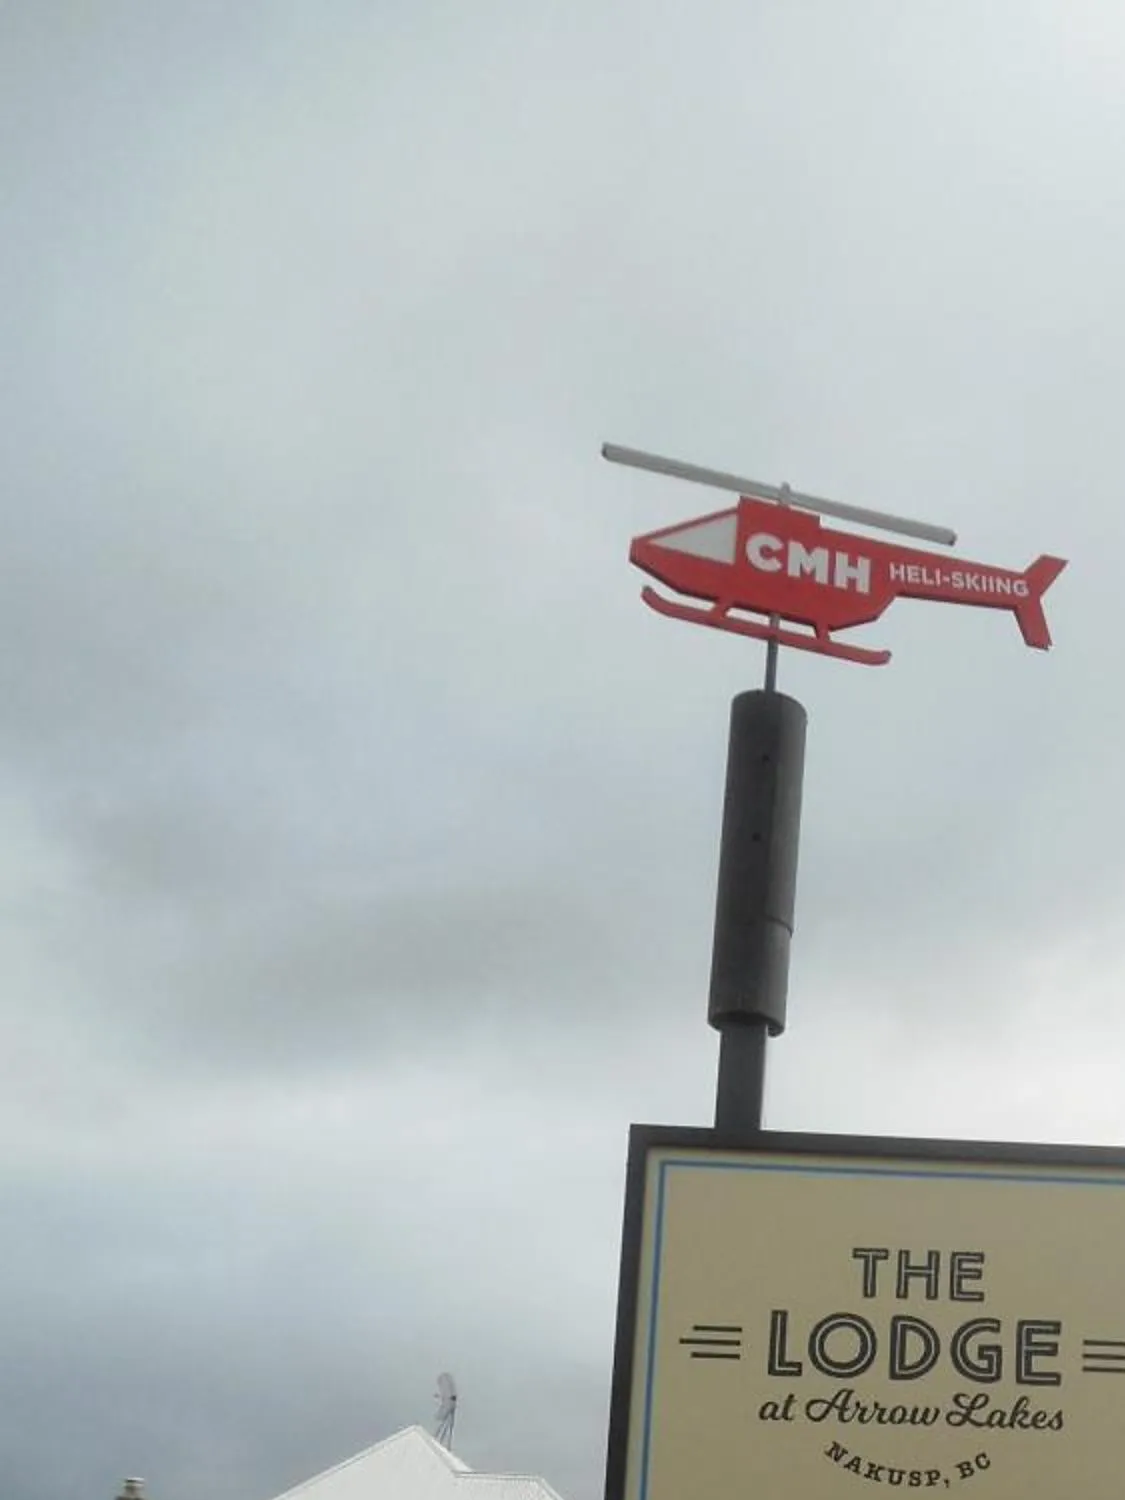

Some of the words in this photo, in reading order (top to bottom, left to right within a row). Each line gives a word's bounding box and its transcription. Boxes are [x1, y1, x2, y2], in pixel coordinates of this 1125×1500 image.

[745, 531, 872, 595] CMH
[889, 561, 1030, 598] HELI-SKIING
[852, 1247, 985, 1302] THE
[767, 1309, 1063, 1387] LODGE
[758, 1392, 798, 1423] at
[805, 1388, 941, 1427] Arrow
[945, 1392, 1065, 1432] Lakes
[823, 1440, 950, 1489] NAKUSP,
[956, 1452, 993, 1481] BC
